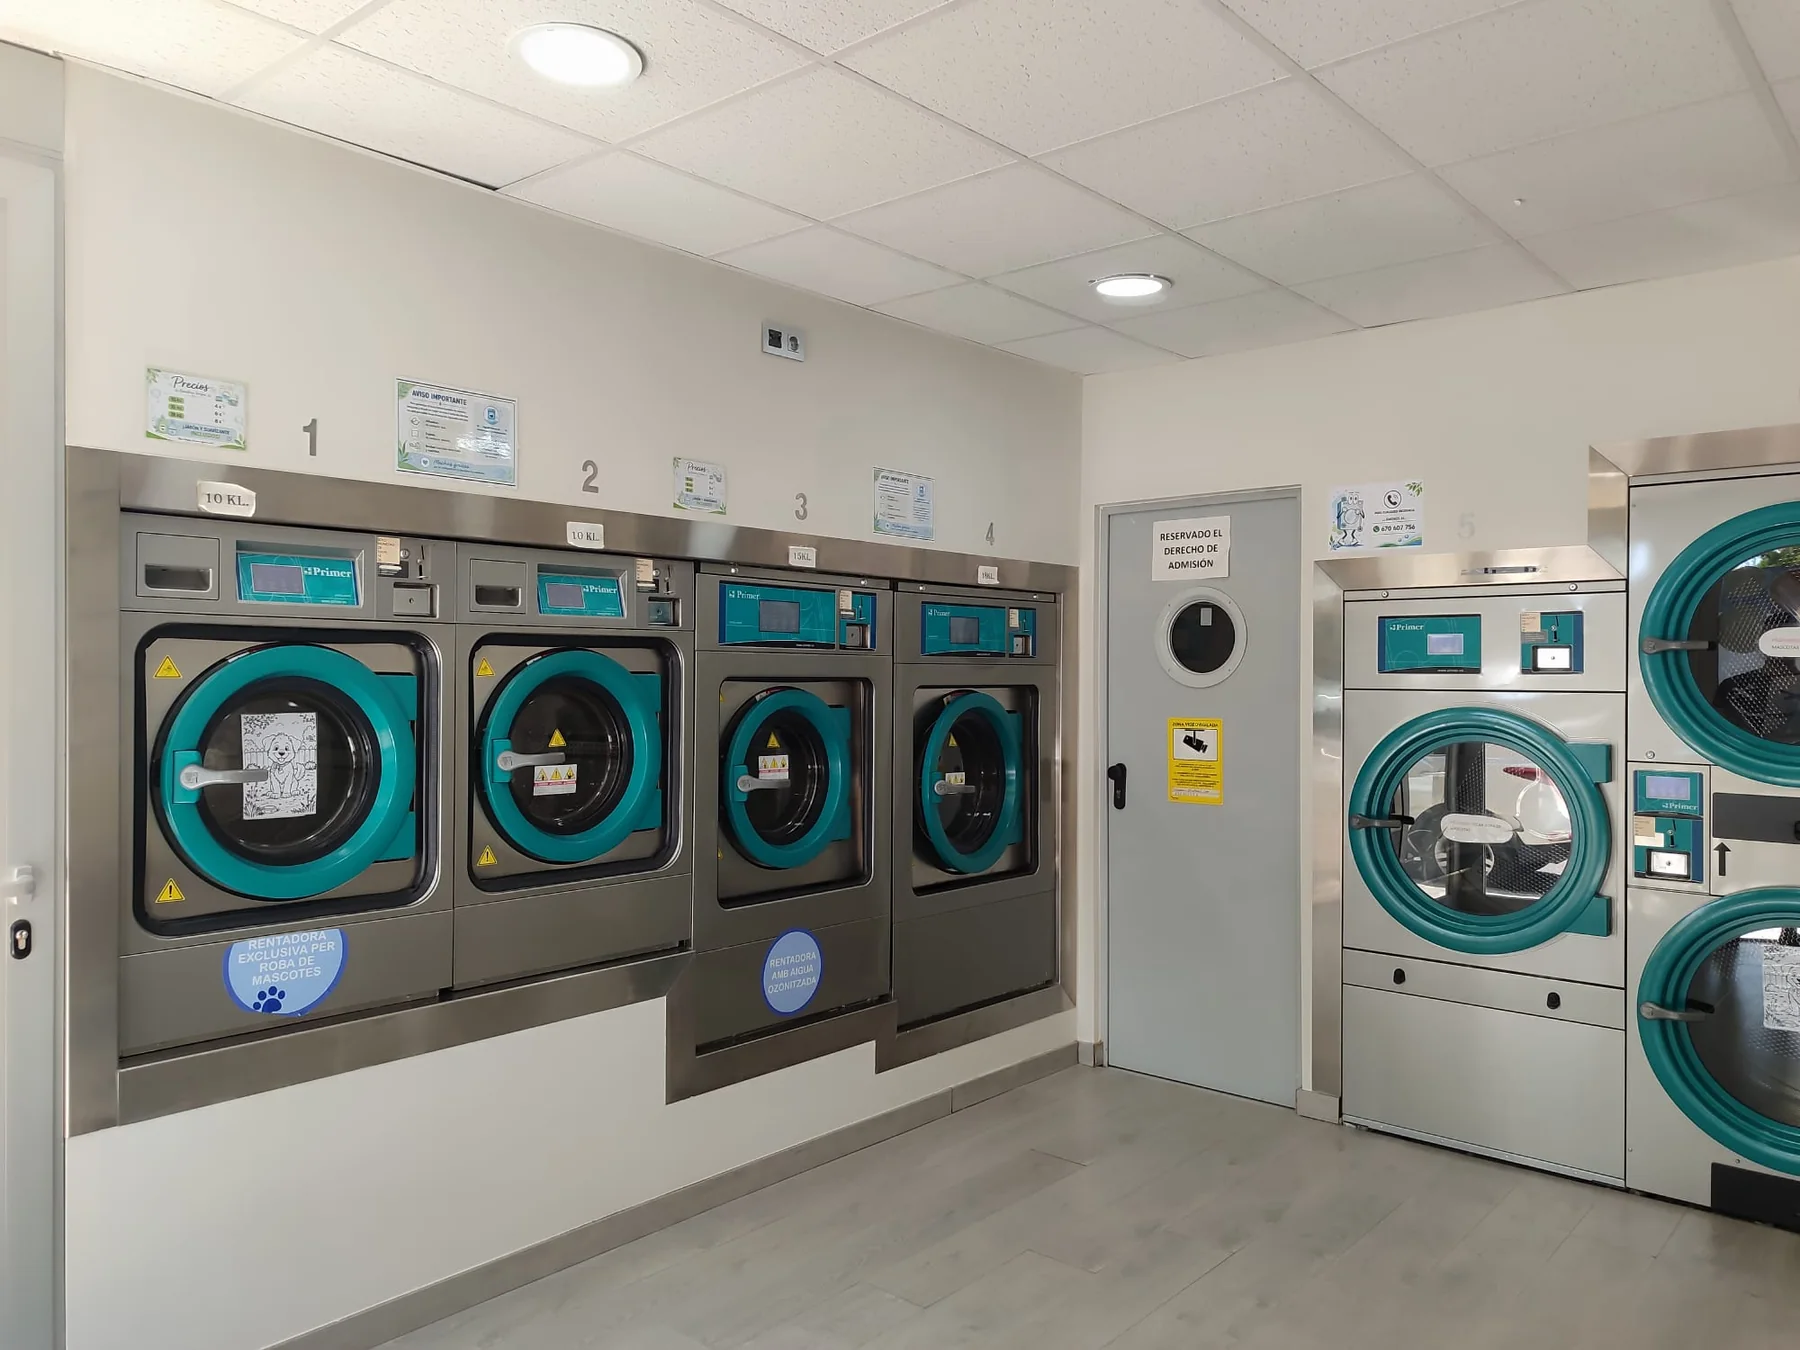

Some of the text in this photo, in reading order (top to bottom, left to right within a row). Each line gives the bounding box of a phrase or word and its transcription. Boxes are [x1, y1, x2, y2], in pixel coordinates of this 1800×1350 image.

[171, 375, 209, 392] Precios
[412, 390, 467, 406] AVISO IMPORTANTE
[302, 418, 317, 456] 1
[582, 460, 599, 493] 2
[205, 492, 223, 504] 10
[795, 492, 808, 520] 3
[985, 521, 995, 546] 4
[1457, 512, 1476, 540] 5
[572, 531, 583, 540] 10
[1160, 529, 1222, 541] RESERVADO EL
[1164, 544, 1218, 555] DERECHO DE
[1168, 557, 1214, 569] ADMISIÓN
[313, 566, 352, 579] Primer
[589, 585, 618, 594] Primer
[736, 590, 761, 600] Primer
[1669, 802, 1698, 811] Primer
[249, 931, 327, 950] RENTADORA
[238, 941, 335, 964] EXCLUSIVA PER
[770, 952, 816, 968] RENTADORA
[260, 956, 315, 973] ROBA DE
[772, 964, 814, 980] AMB AIGUA
[252, 967, 321, 986] MASCOTES
[768, 976, 816, 994] OZONITZADA
